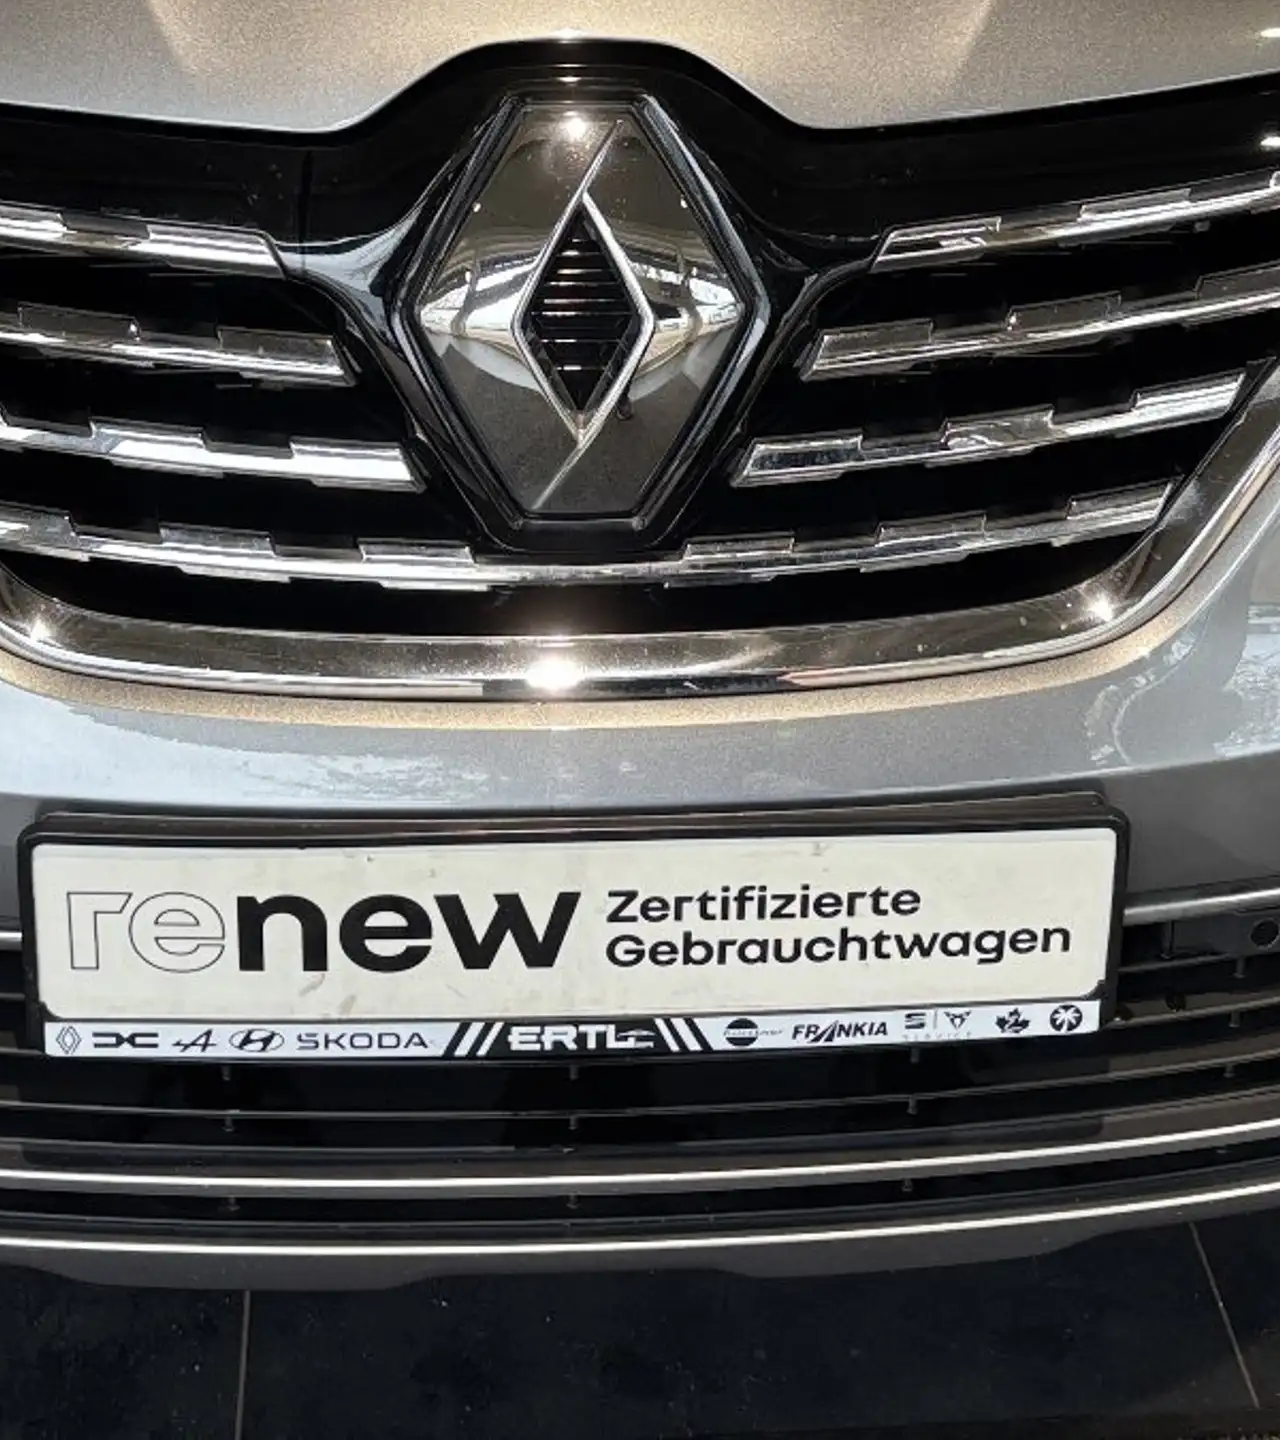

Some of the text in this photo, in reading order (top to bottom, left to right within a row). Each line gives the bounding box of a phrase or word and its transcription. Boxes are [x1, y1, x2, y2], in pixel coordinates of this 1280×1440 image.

[606, 883, 920, 923] Zertifizierte
[67, 891, 582, 973] renew
[606, 926, 1071, 967] Gebrauchtwagen
[791, 1020, 888, 1043] FRANKIA
